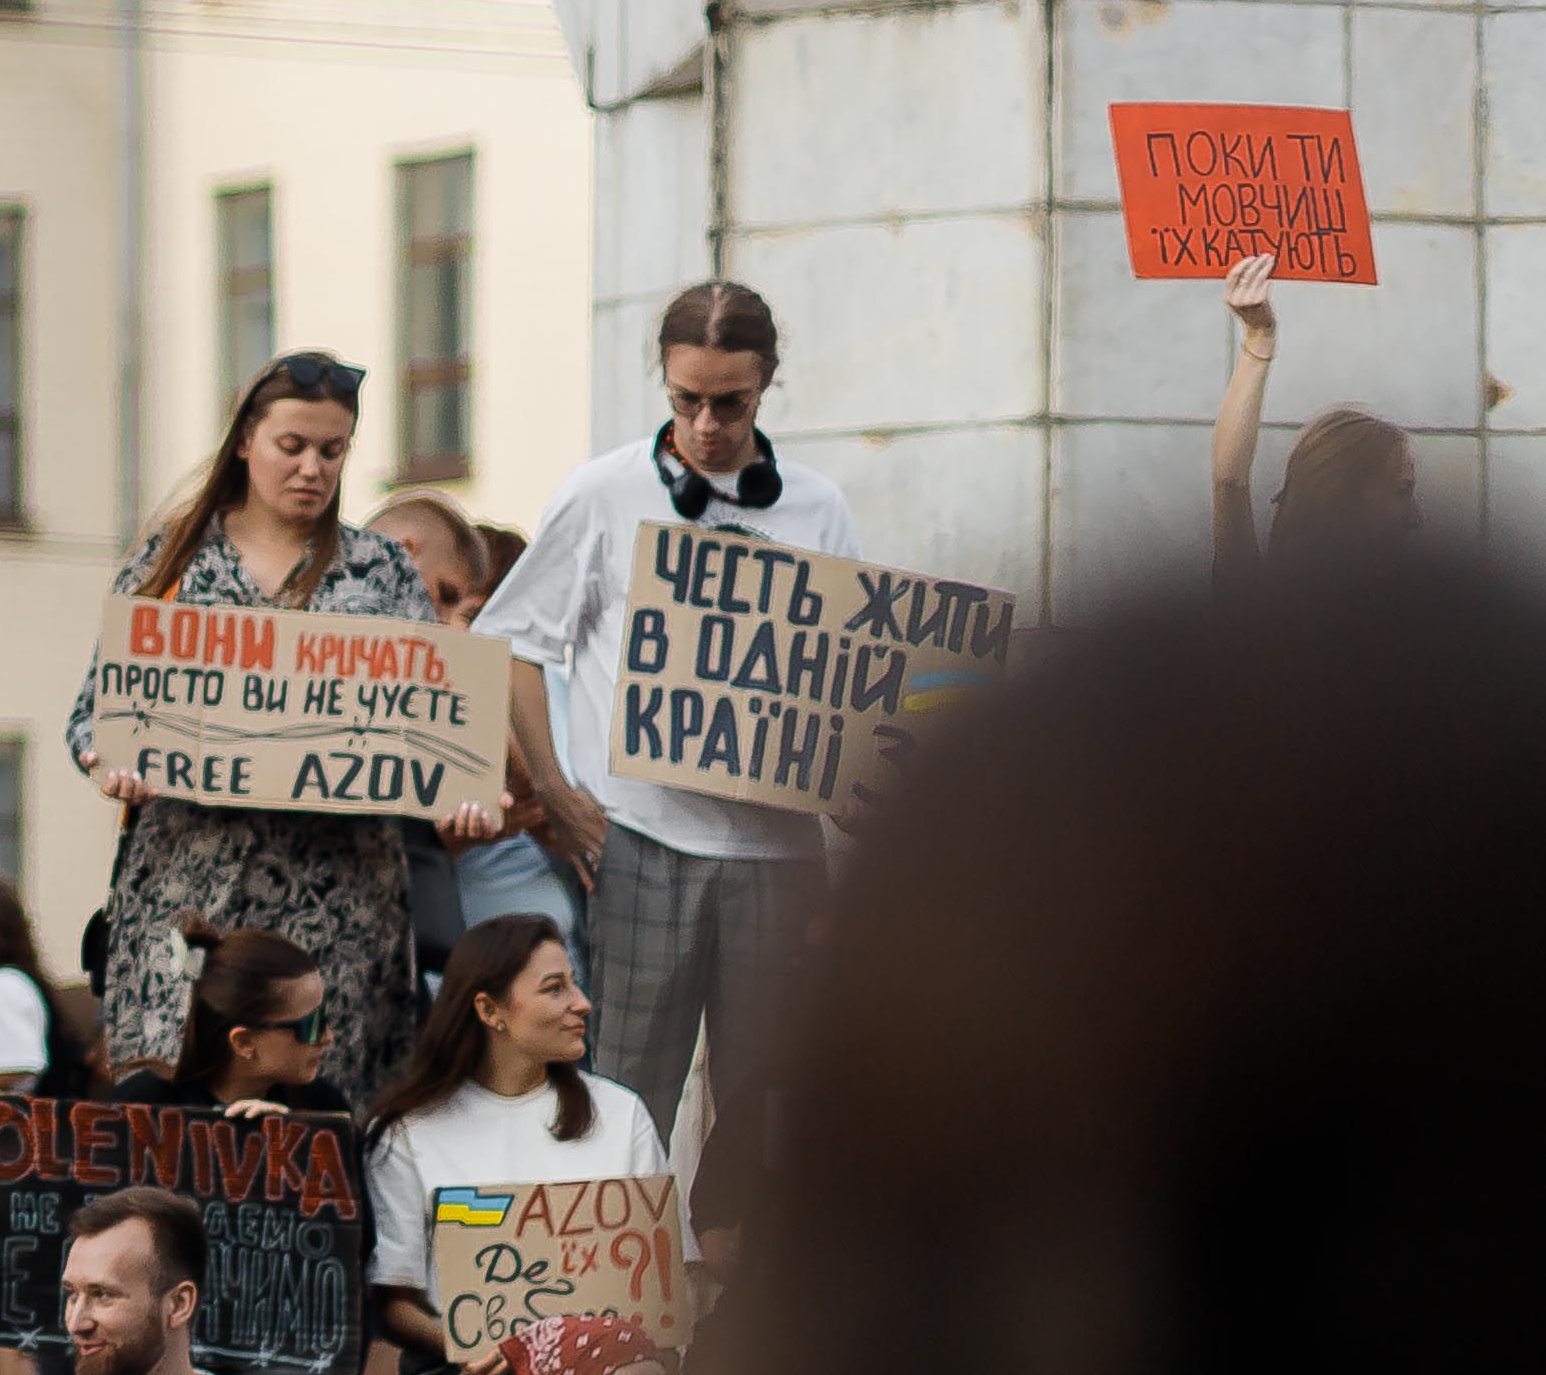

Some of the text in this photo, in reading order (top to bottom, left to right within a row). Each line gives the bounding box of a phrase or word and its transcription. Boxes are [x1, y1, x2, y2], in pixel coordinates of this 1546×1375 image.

[1147, 130, 1345, 183] ПОКИ ТИ
[1178, 182, 1347, 233] МОВЧИШ
[1150, 227, 1357, 276] ЇХ КАТУЮТЬ
[656, 529, 1015, 667] ЧЕСТЬ ЖИТИ
[130, 604, 276, 671] ВОНИ
[628, 608, 669, 674] В
[101, 662, 225, 707] ПРОСТО
[243, 673, 288, 713] ВИ
[303, 679, 345, 716] НЕ
[137, 747, 445, 807] FREE AZOV
[10, 1192, 61, 1234] НЕ
[515, 1175, 676, 1238] AZOV
[475, 1243, 548, 1284] Де
